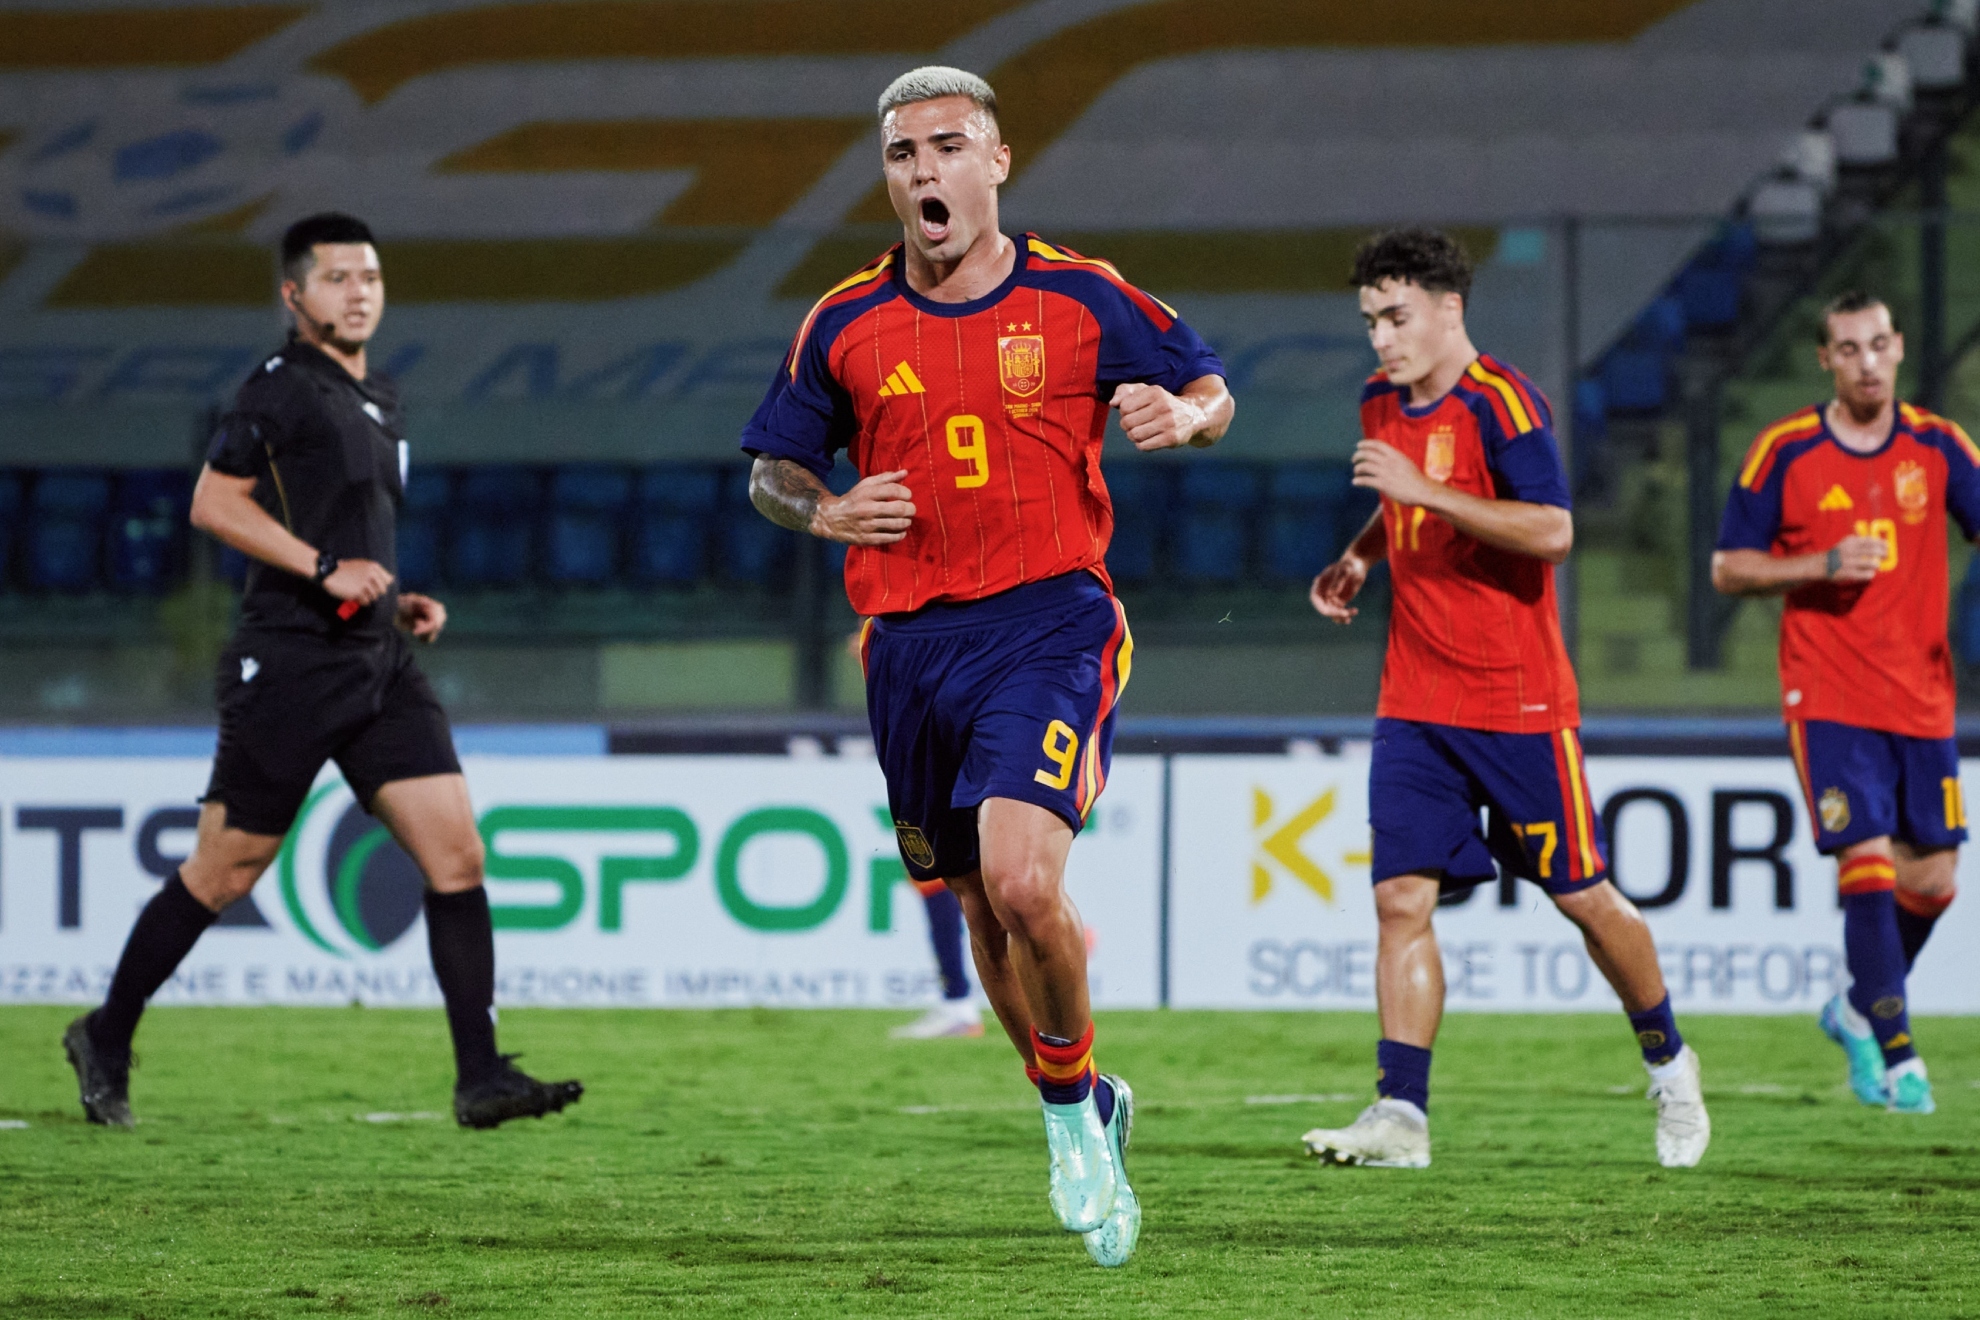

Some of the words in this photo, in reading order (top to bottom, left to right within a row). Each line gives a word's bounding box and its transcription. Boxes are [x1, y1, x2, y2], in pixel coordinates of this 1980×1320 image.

[945, 414, 989, 489] 9
[1033, 719, 1079, 791] 9
[476, 805, 1098, 934] SPO
[664, 966, 870, 995] IMPIANTI
[1516, 940, 1591, 1000] TO
